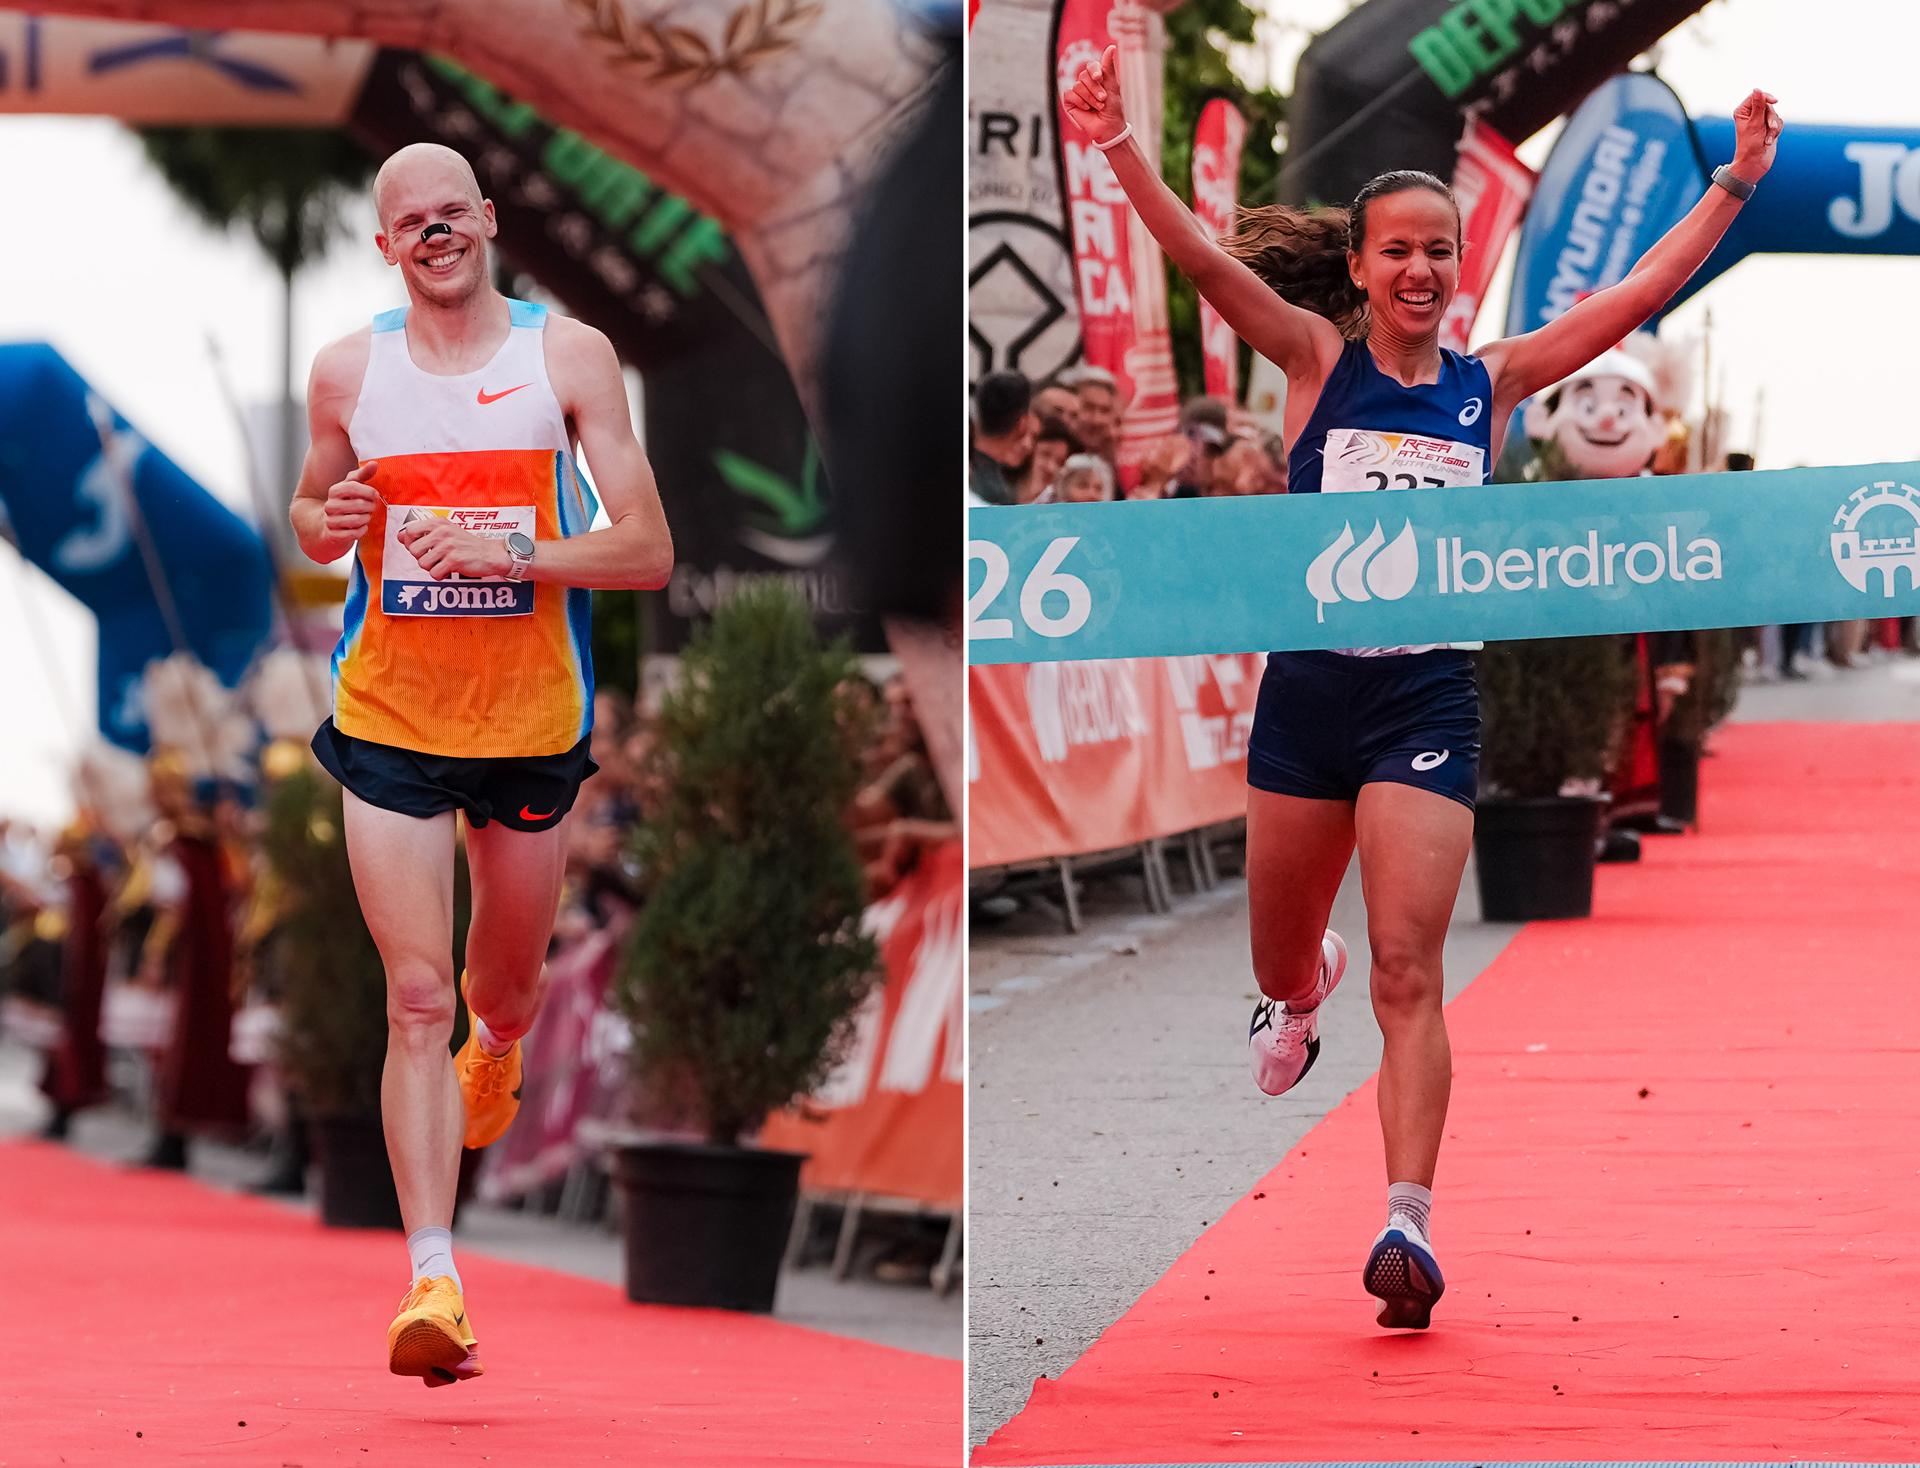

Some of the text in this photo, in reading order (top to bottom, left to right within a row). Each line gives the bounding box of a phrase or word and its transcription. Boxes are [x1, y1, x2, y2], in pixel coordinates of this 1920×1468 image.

[968, 111, 1043, 158] RI
[1403, 438, 1453, 454] RFEA
[1397, 450, 1471, 469] ATLETISMO
[450, 510, 500, 523] RFEA
[453, 521, 520, 531] TLETISMO
[1436, 525, 1723, 594] Iberdrola
[423, 585, 517, 612] Joma
[968, 536, 1093, 640] 26
